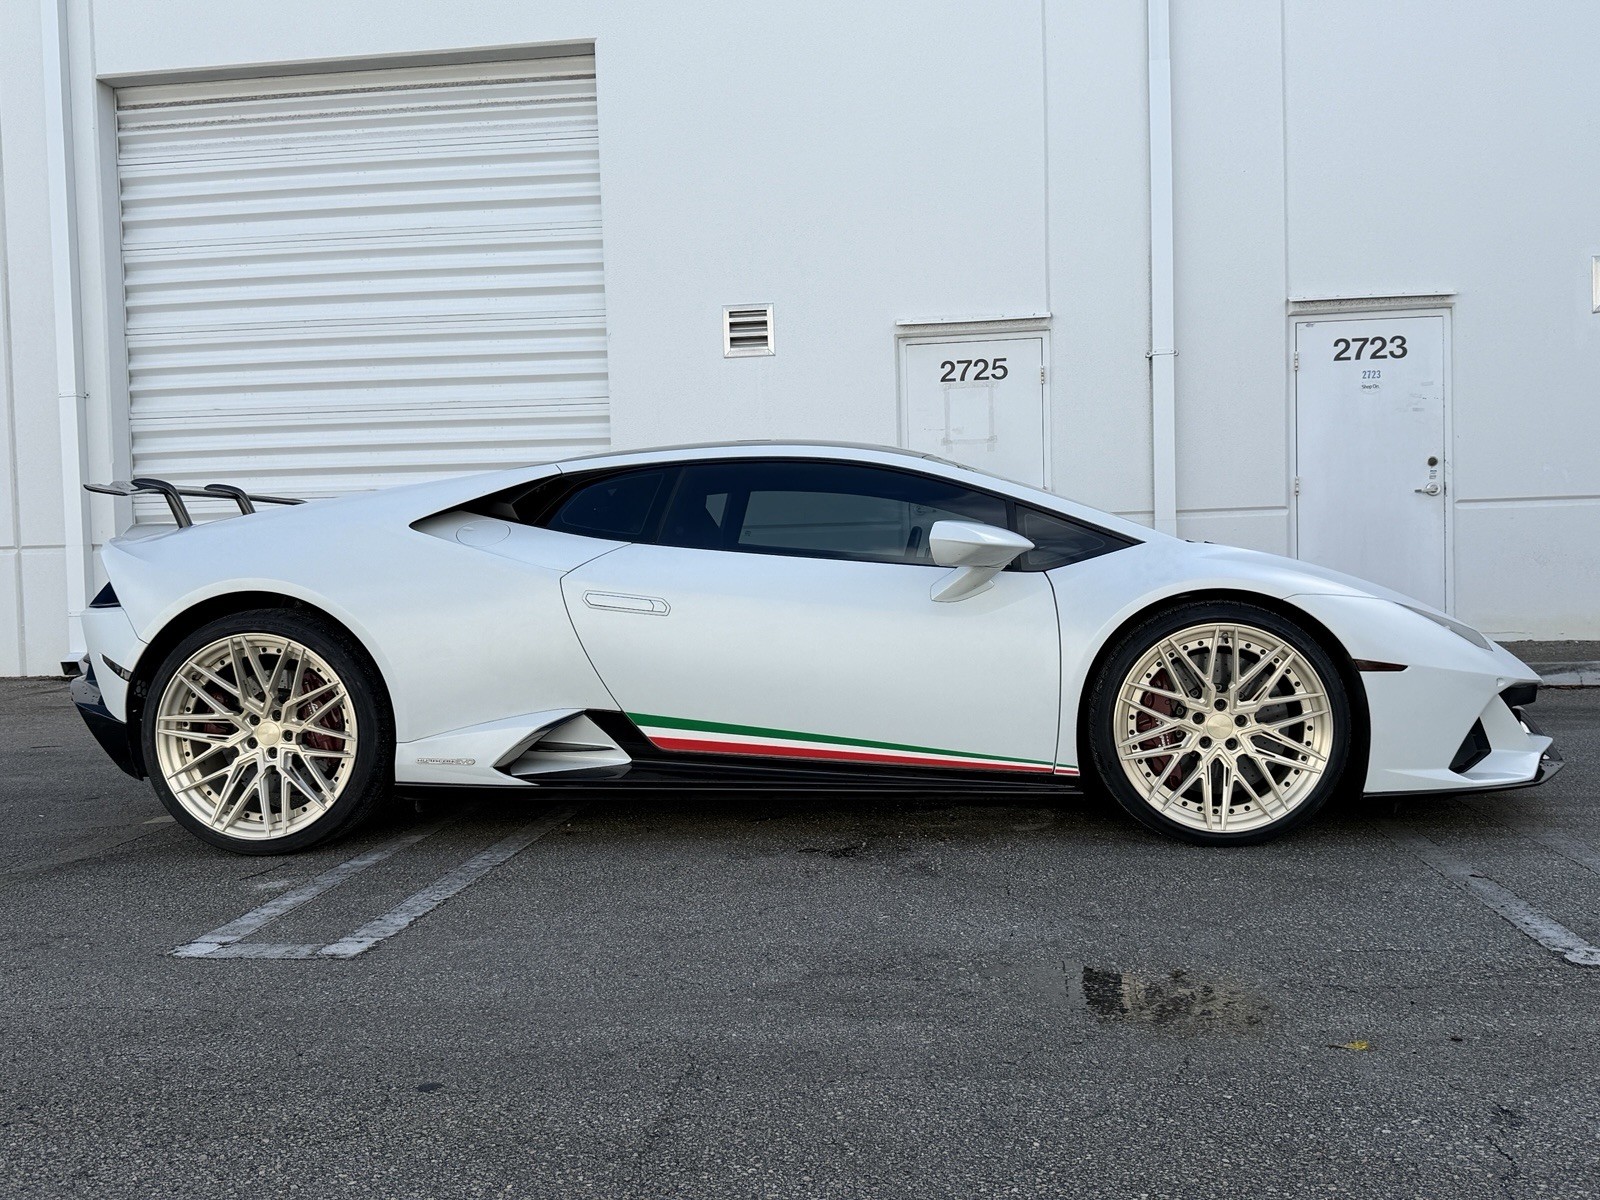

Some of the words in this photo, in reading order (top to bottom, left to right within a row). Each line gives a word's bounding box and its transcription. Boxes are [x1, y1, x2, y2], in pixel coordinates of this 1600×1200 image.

[1333, 335, 1408, 361] 2723
[940, 357, 1008, 382] 2725
[1362, 370, 1381, 379] 2723
